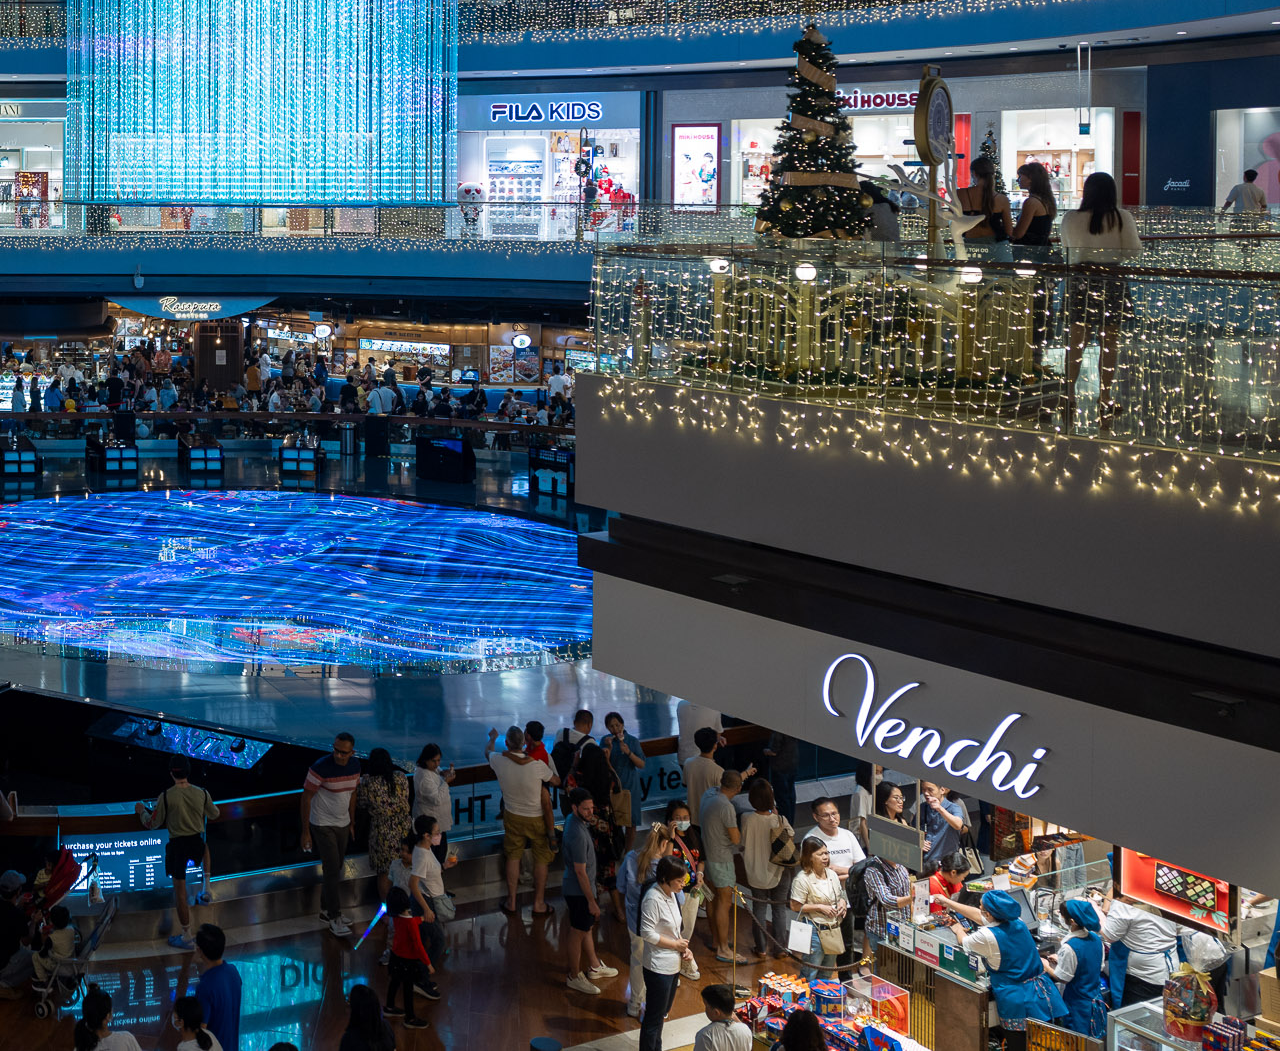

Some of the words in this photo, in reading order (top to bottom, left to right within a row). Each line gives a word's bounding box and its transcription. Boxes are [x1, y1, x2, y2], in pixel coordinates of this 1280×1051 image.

[836, 90, 860, 109] iki
[490, 103, 543, 122] FILA
[549, 101, 602, 121] KIDS
[159, 296, 222, 313] Rasapura
[822, 653, 1049, 800] Venchi
[64, 842, 95, 851] urchase
[96, 840, 113, 851] your
[114, 839, 138, 848] tickets
[139, 837, 162, 847] online
[919, 938, 934, 949] OPEN
